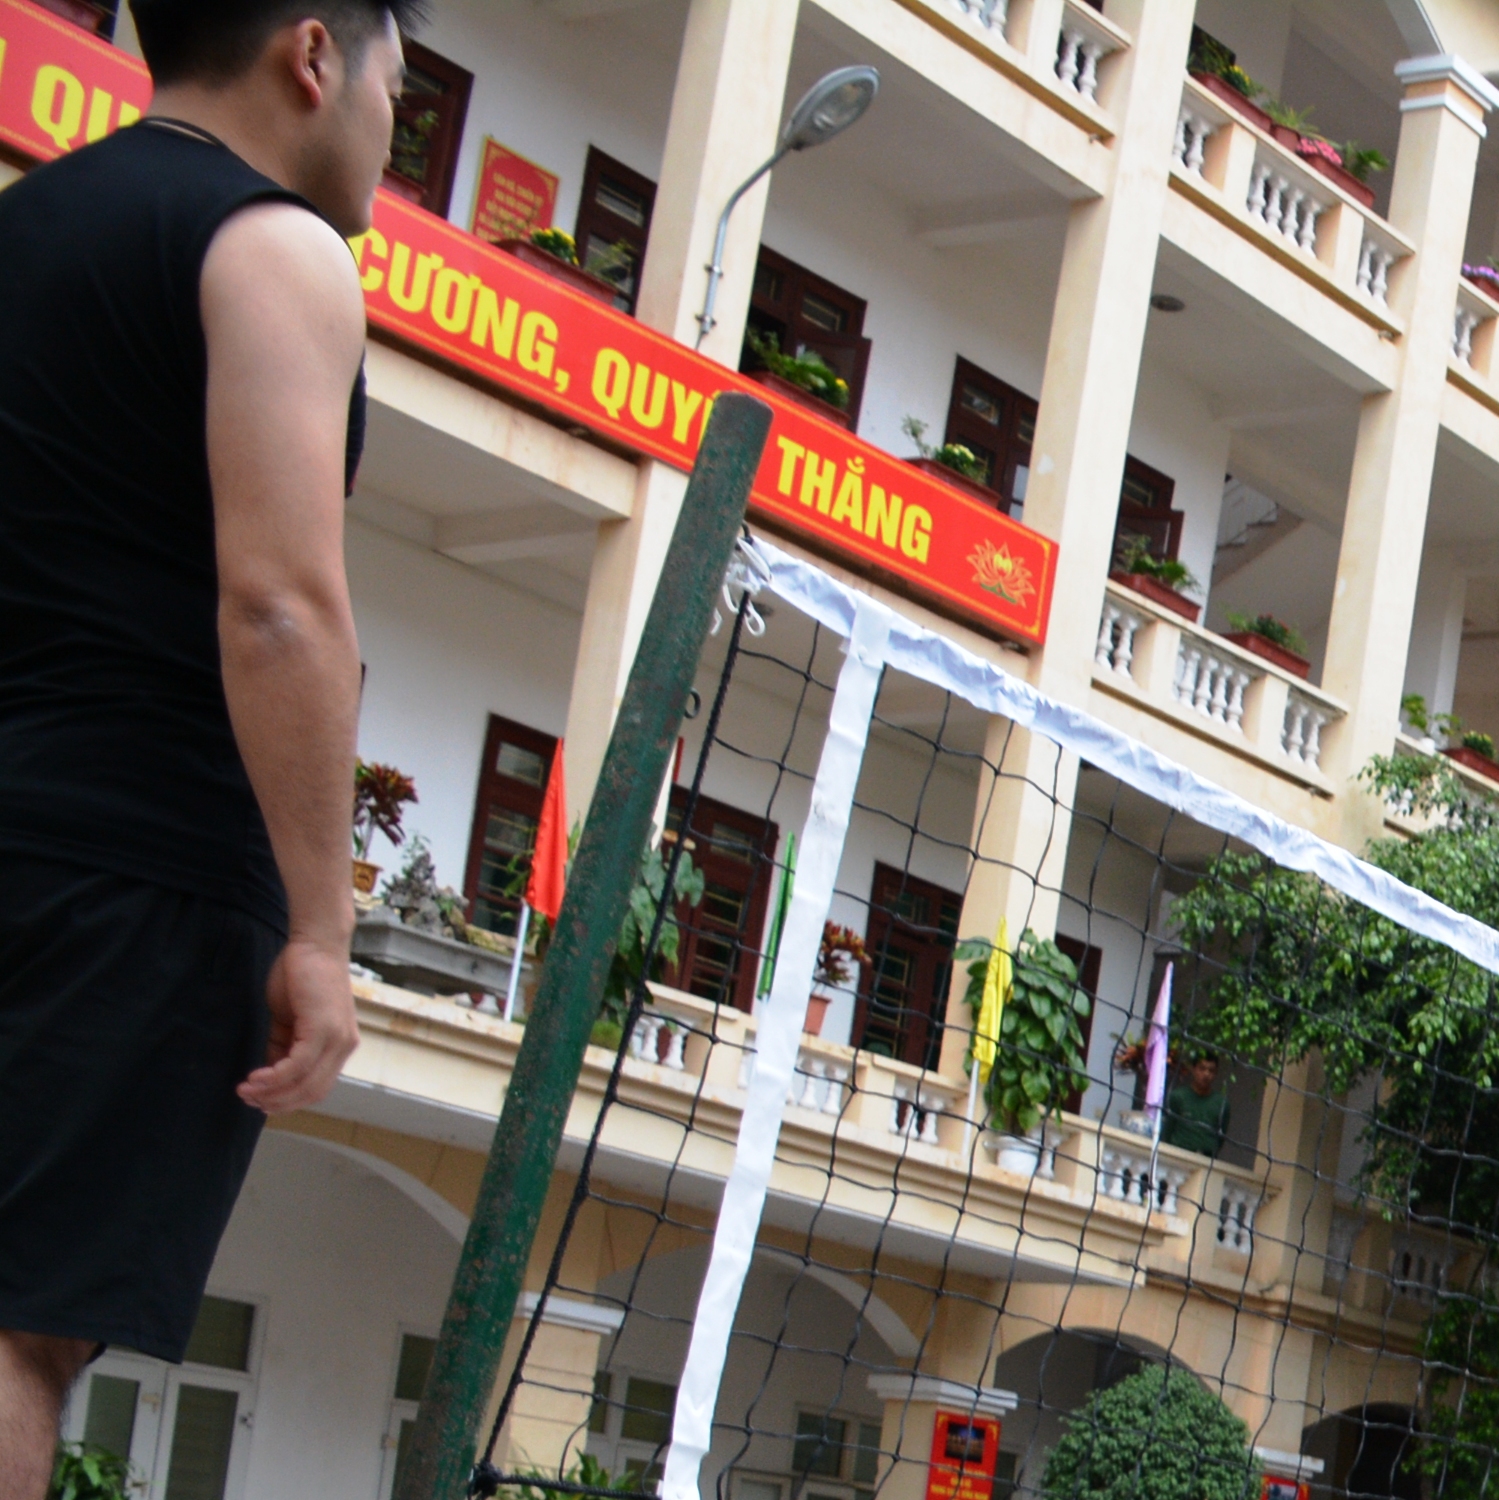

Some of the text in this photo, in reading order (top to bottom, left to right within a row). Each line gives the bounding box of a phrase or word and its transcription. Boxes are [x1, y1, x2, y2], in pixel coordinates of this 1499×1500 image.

[353, 229, 570, 394] CƯƠNG,
[591, 347, 722, 446] QUY
[777, 434, 933, 565] THẮNG
